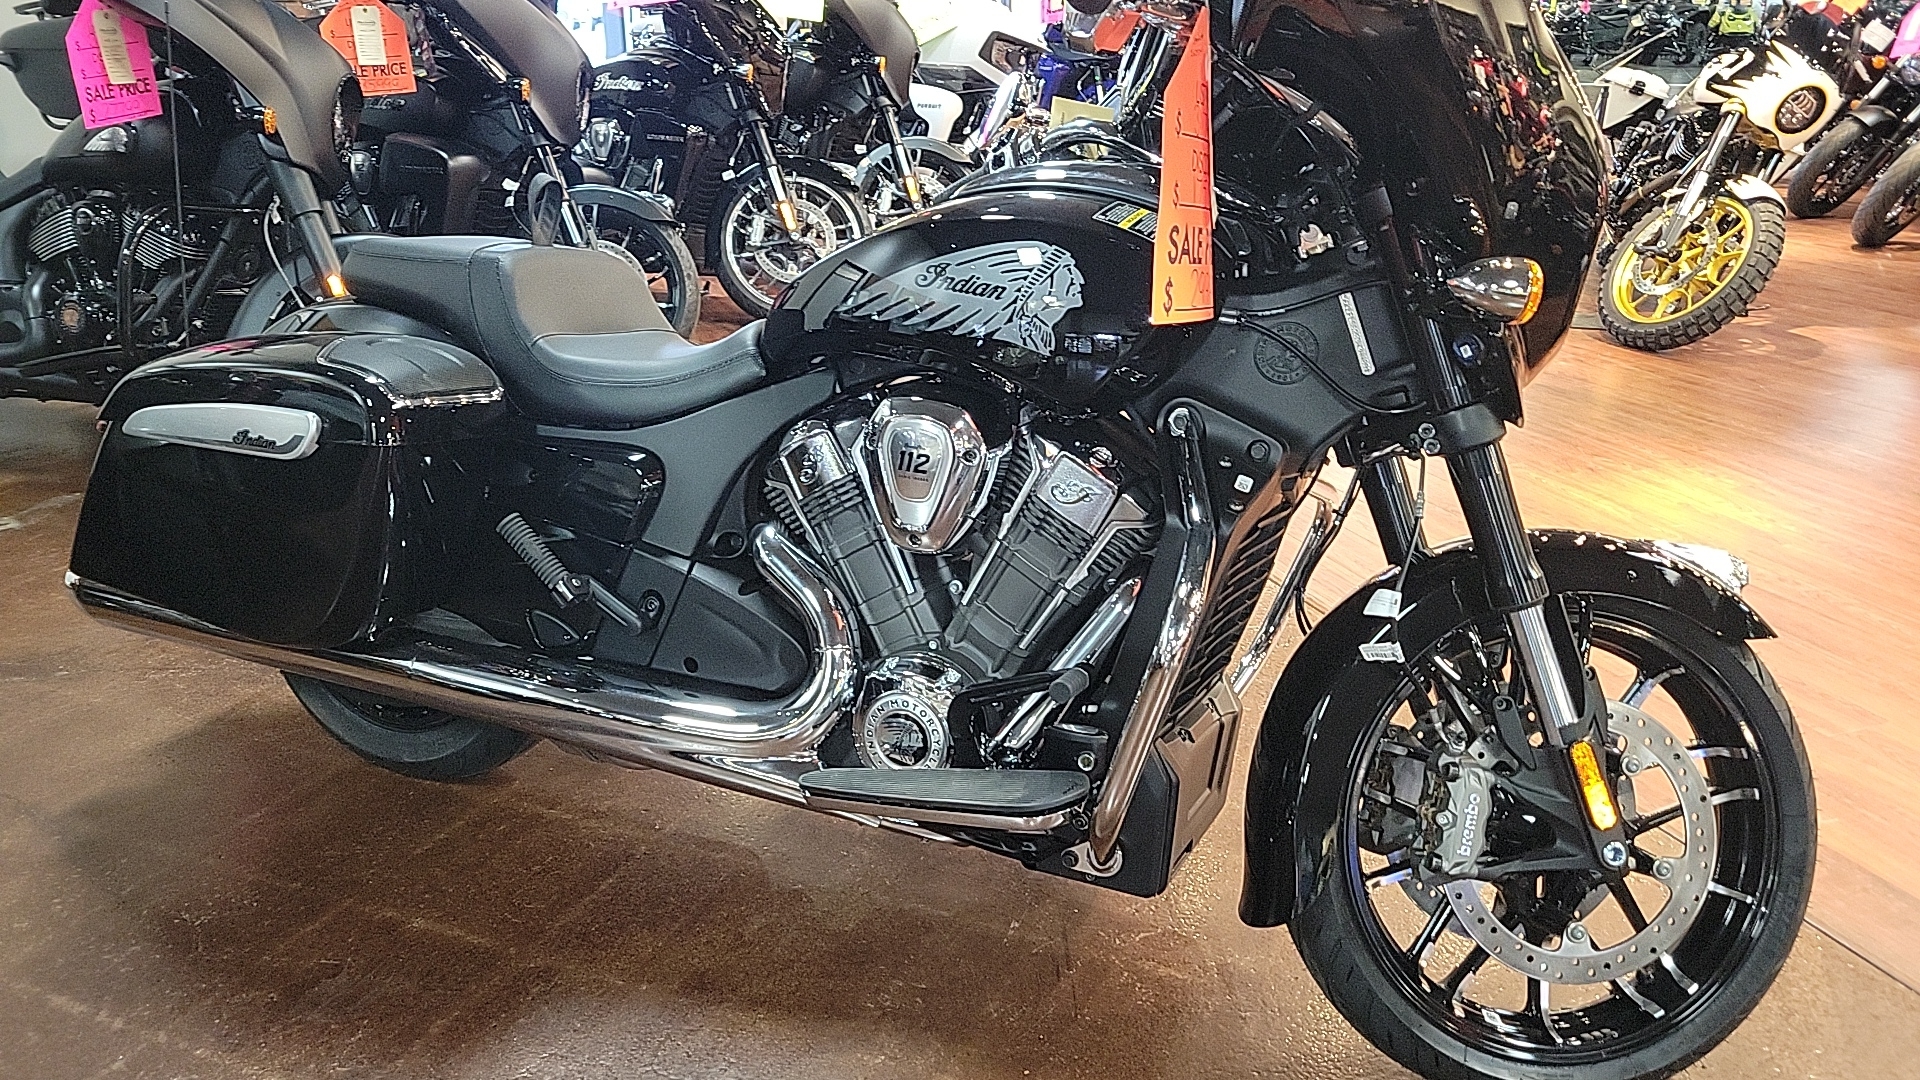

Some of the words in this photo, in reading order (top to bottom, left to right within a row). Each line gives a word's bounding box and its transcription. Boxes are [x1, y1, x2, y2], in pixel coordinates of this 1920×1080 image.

[372, 62, 407, 77] PRICE
[85, 83, 116, 103] SALE
[119, 77, 152, 98] PRICE
[1167, 223, 1203, 265] SALE
[914, 262, 1008, 301] Indian
[1163, 276, 1174, 317] $
[232, 428, 277, 449] Indian
[897, 450, 930, 475] 112
[866, 704, 886, 757] INDIAN
[889, 699, 941, 769] MOTORCYCLE
[1456, 792, 1481, 857] brembo
